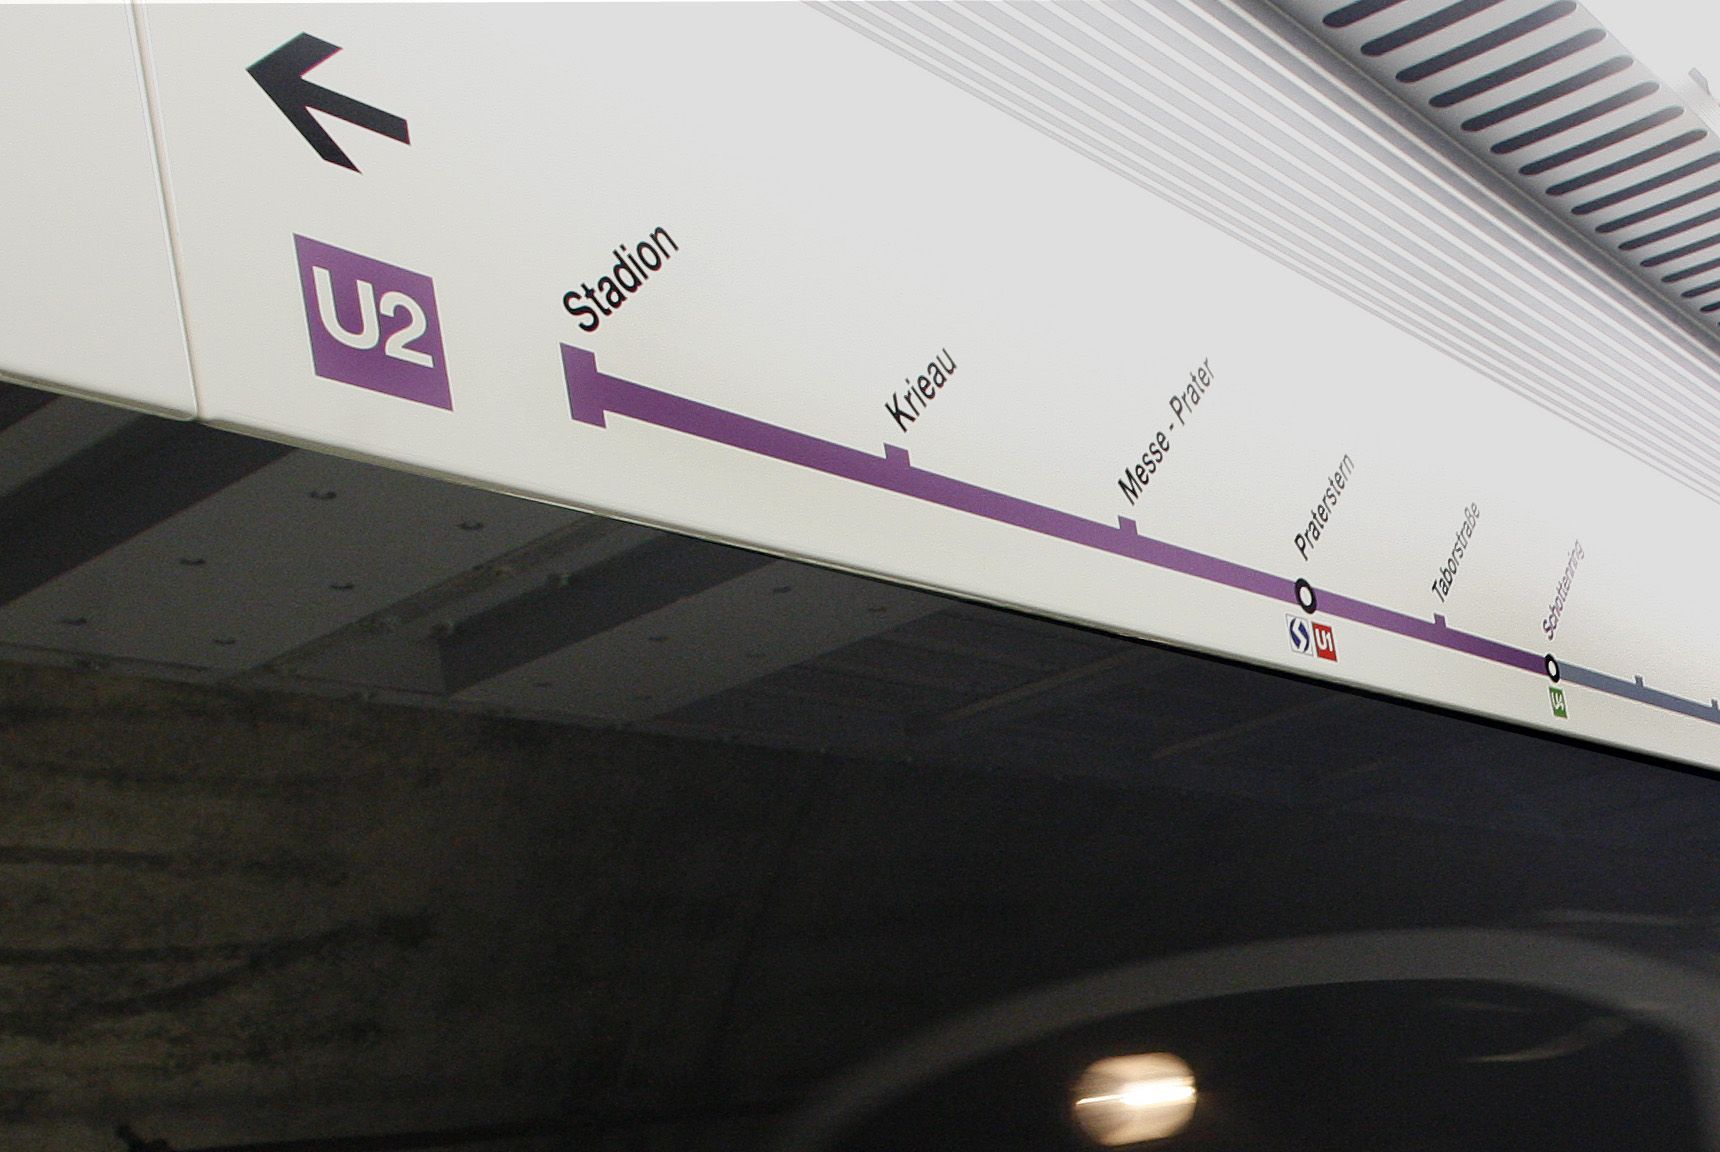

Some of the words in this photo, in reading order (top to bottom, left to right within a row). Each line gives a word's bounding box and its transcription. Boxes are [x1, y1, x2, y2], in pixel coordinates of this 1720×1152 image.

[311, 265, 435, 368] U2
[562, 224, 681, 334] Stadion
[884, 346, 958, 434] Krieau
[1117, 431, 1170, 506] Messe
[1169, 357, 1215, 426] Prater
[1294, 453, 1355, 561] Praterstern
[1432, 502, 1480, 603] Taborstraße
[1315, 628, 1334, 653] U1
[1543, 538, 1585, 641] Schottenring
